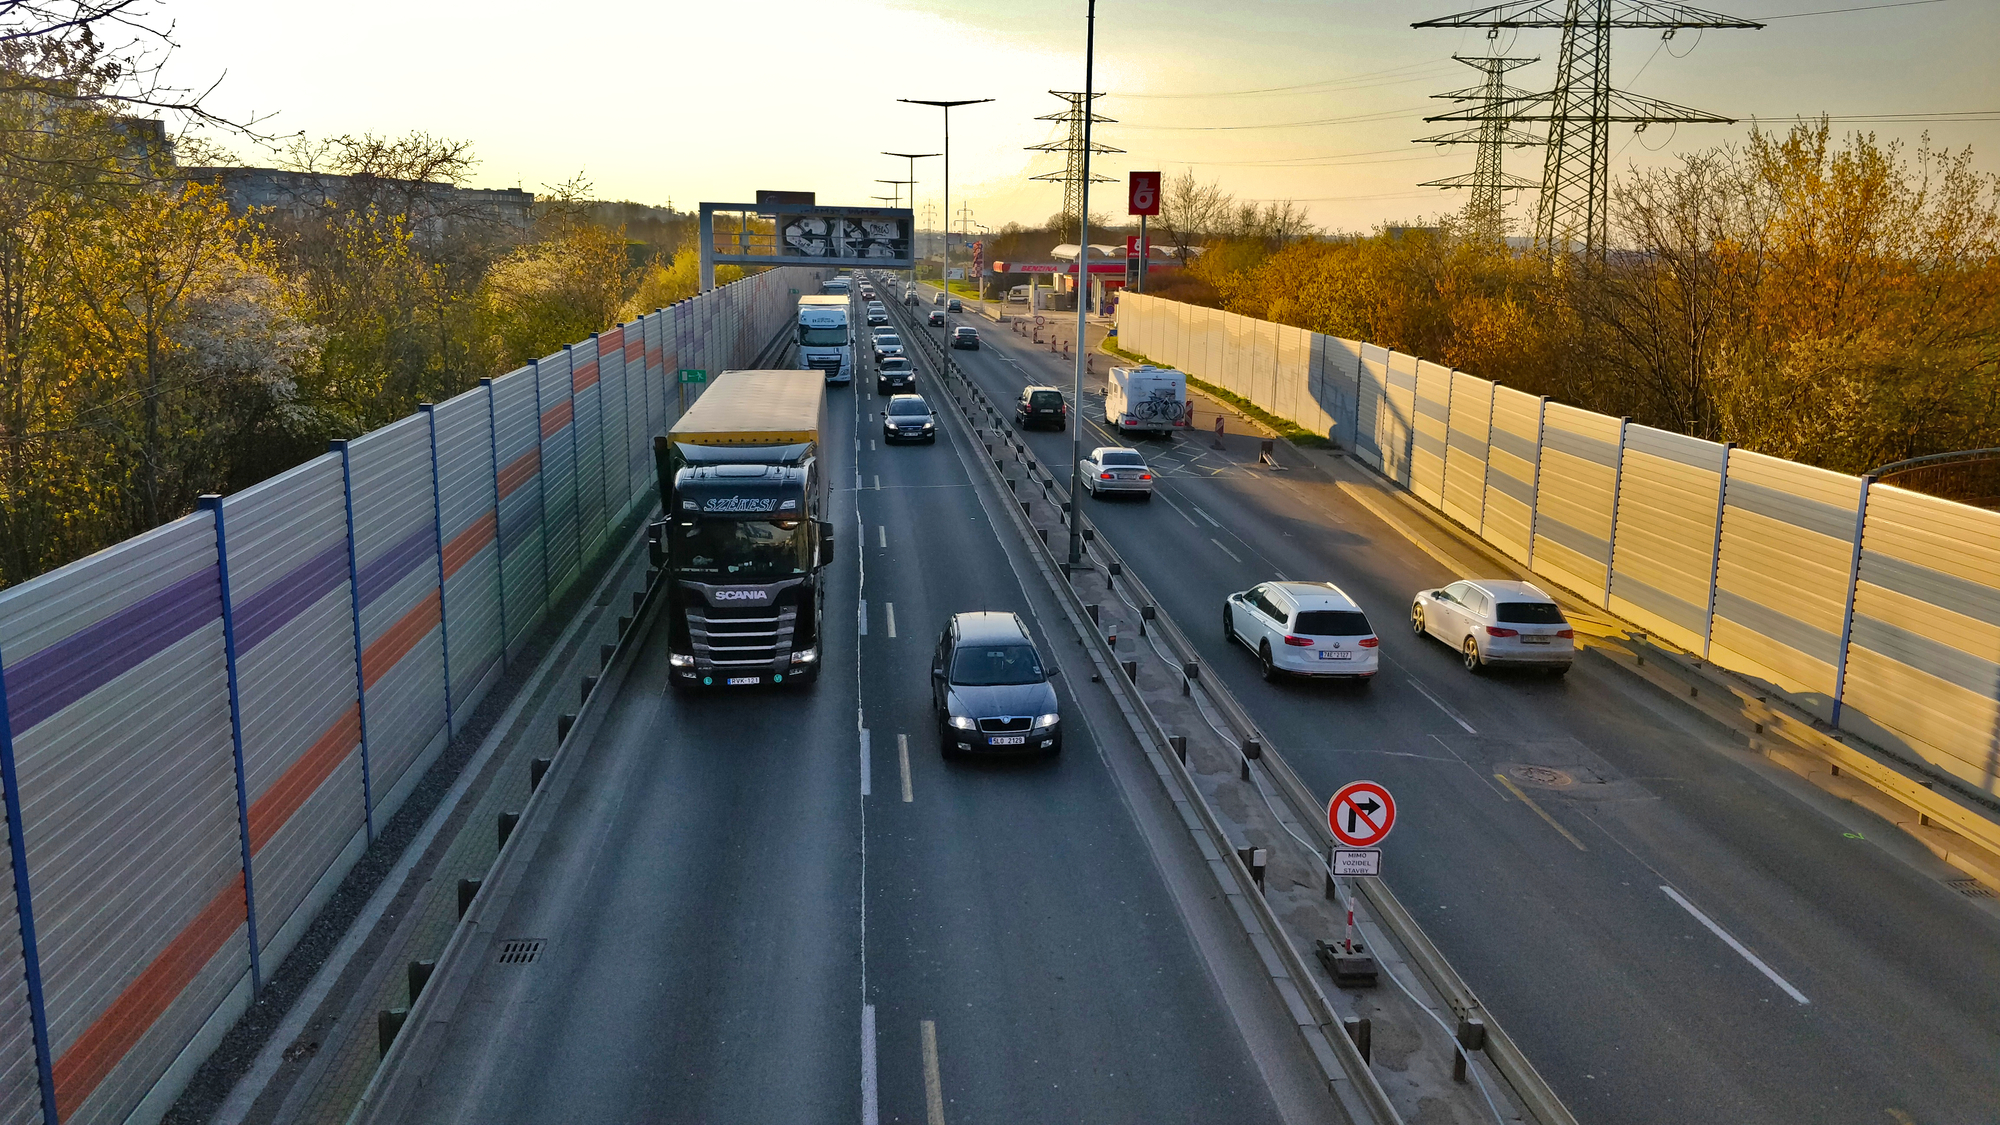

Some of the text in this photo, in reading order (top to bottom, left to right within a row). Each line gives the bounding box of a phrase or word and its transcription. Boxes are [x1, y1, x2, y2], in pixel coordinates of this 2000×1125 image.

[1020, 265, 1058, 273] BENZINA
[703, 495, 777, 512] SZÉKESI
[715, 590, 767, 600] SCANIA
